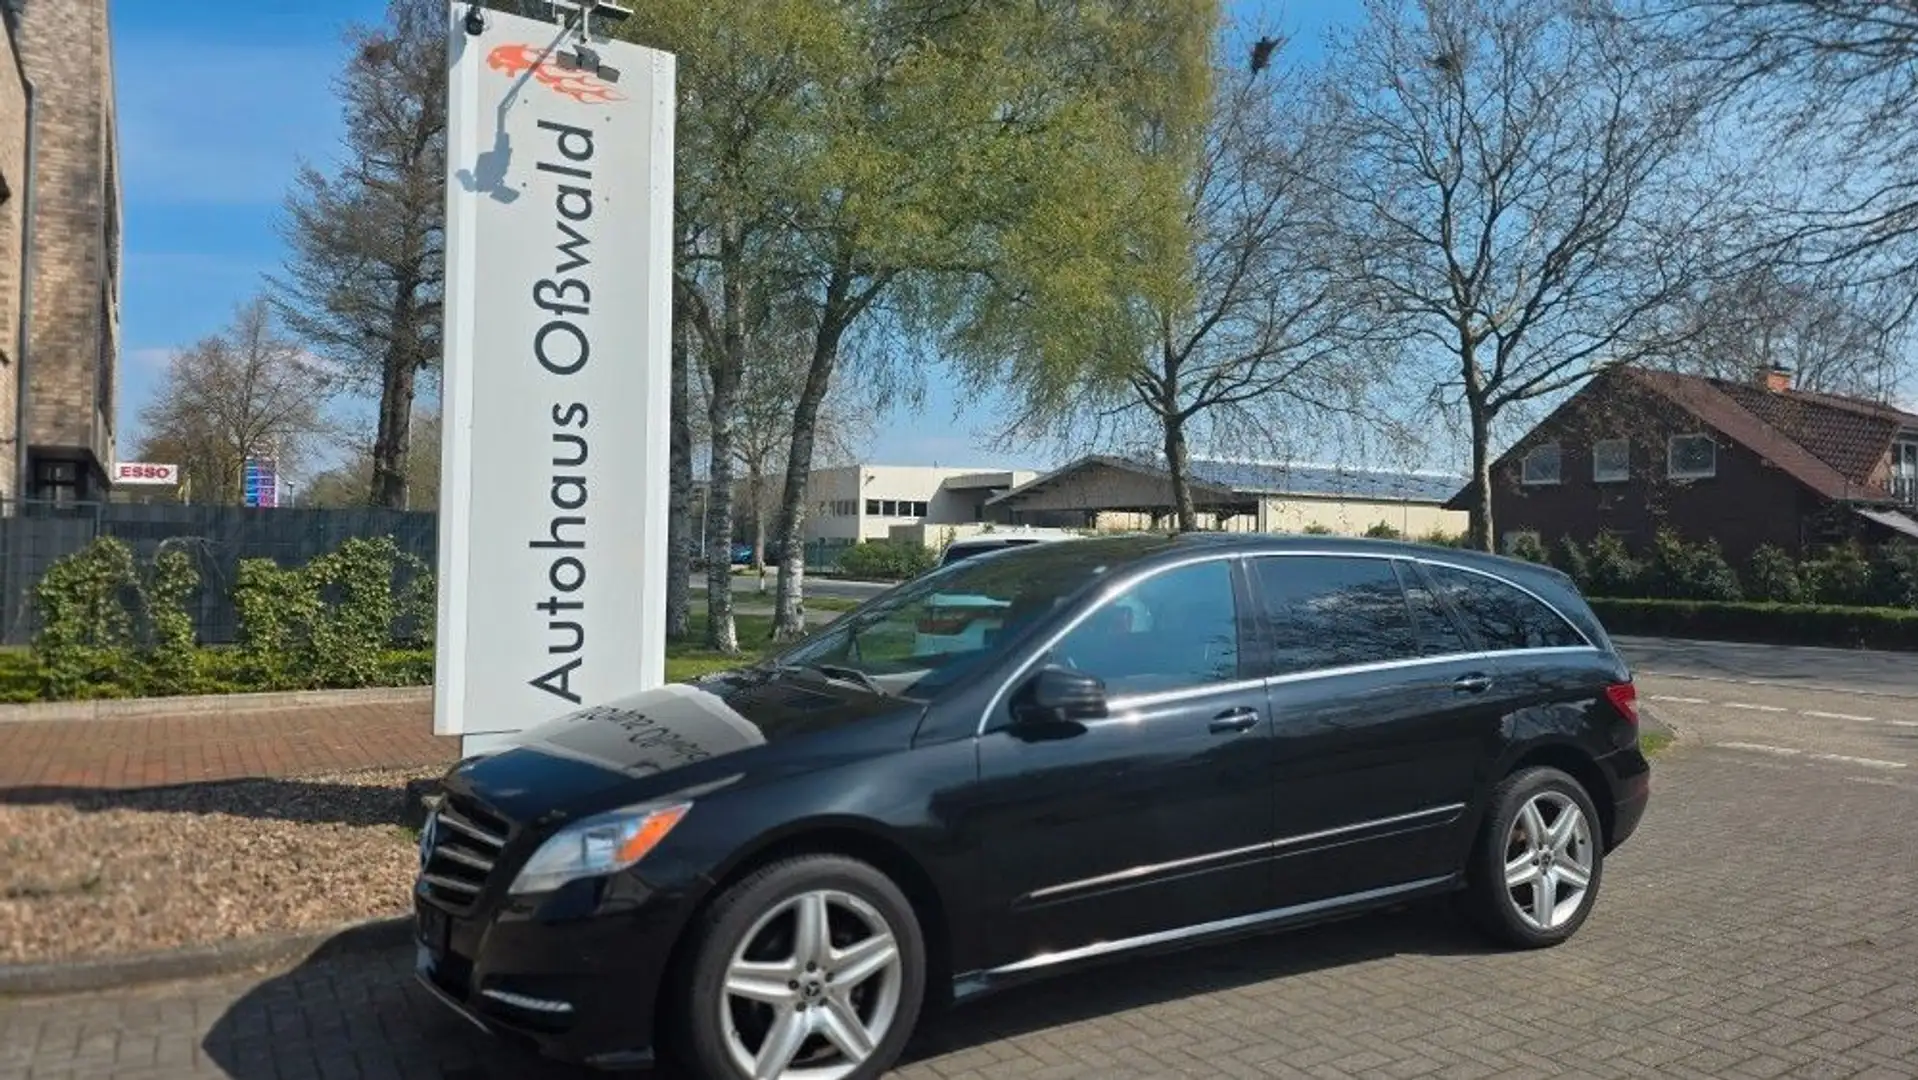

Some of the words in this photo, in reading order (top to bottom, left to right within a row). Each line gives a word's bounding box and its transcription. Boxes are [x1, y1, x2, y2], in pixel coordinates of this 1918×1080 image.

[533, 119, 594, 376] Oßwald
[119, 465, 170, 479] ESSO
[528, 402, 589, 705] Autohaus
